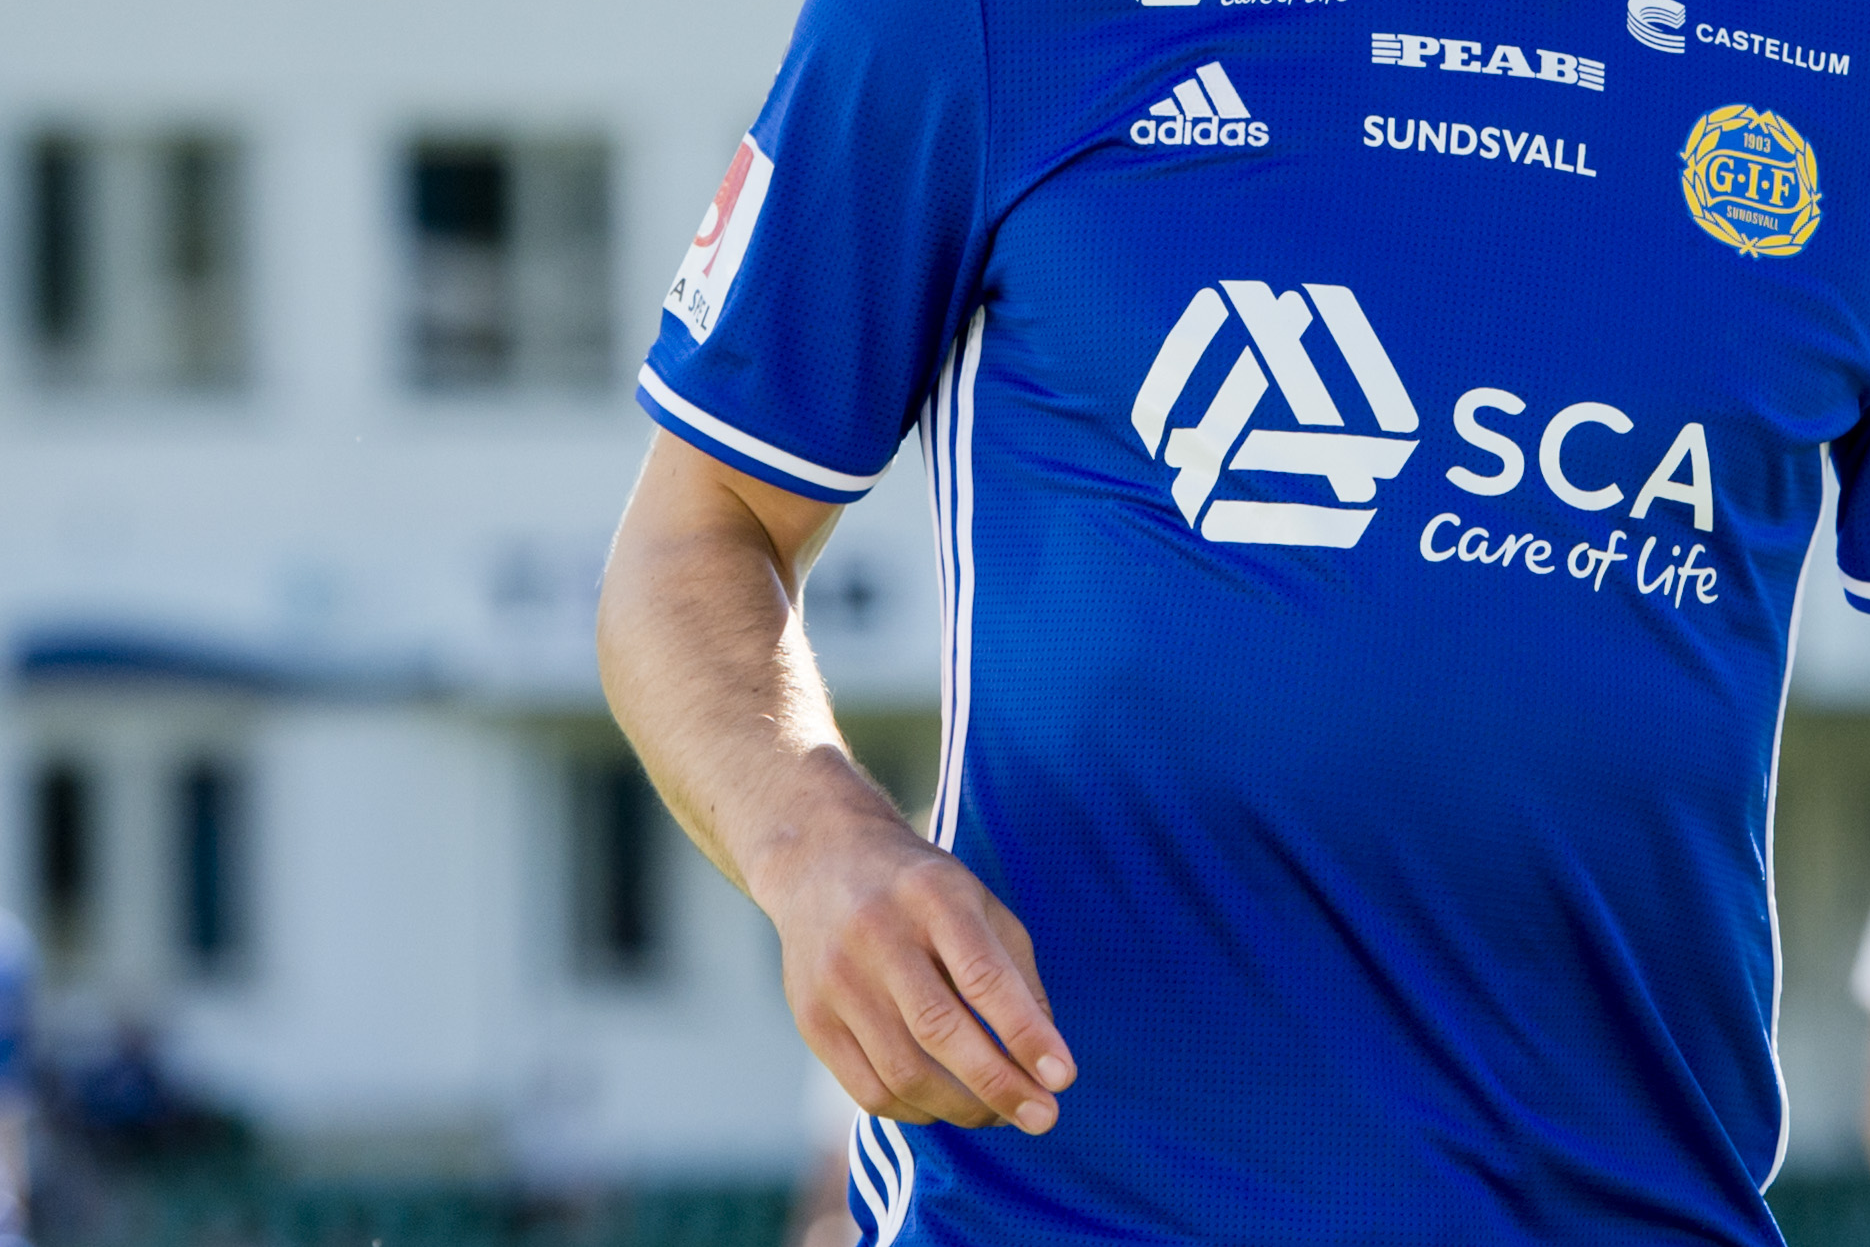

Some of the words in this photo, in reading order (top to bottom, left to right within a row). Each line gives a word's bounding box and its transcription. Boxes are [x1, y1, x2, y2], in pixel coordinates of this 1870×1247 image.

[1397, 33, 1579, 85] PEAB
[1695, 22, 1850, 76] CASTELLUM
[1129, 113, 1270, 147] adidas
[1363, 115, 1597, 178] SUNDSVALL
[1743, 132, 1771, 154] 1903
[1726, 205, 1779, 231] SUNDSVALL
[1446, 387, 1714, 532] SCA
[1419, 512, 1556, 575] Care
[1567, 529, 1628, 592] of
